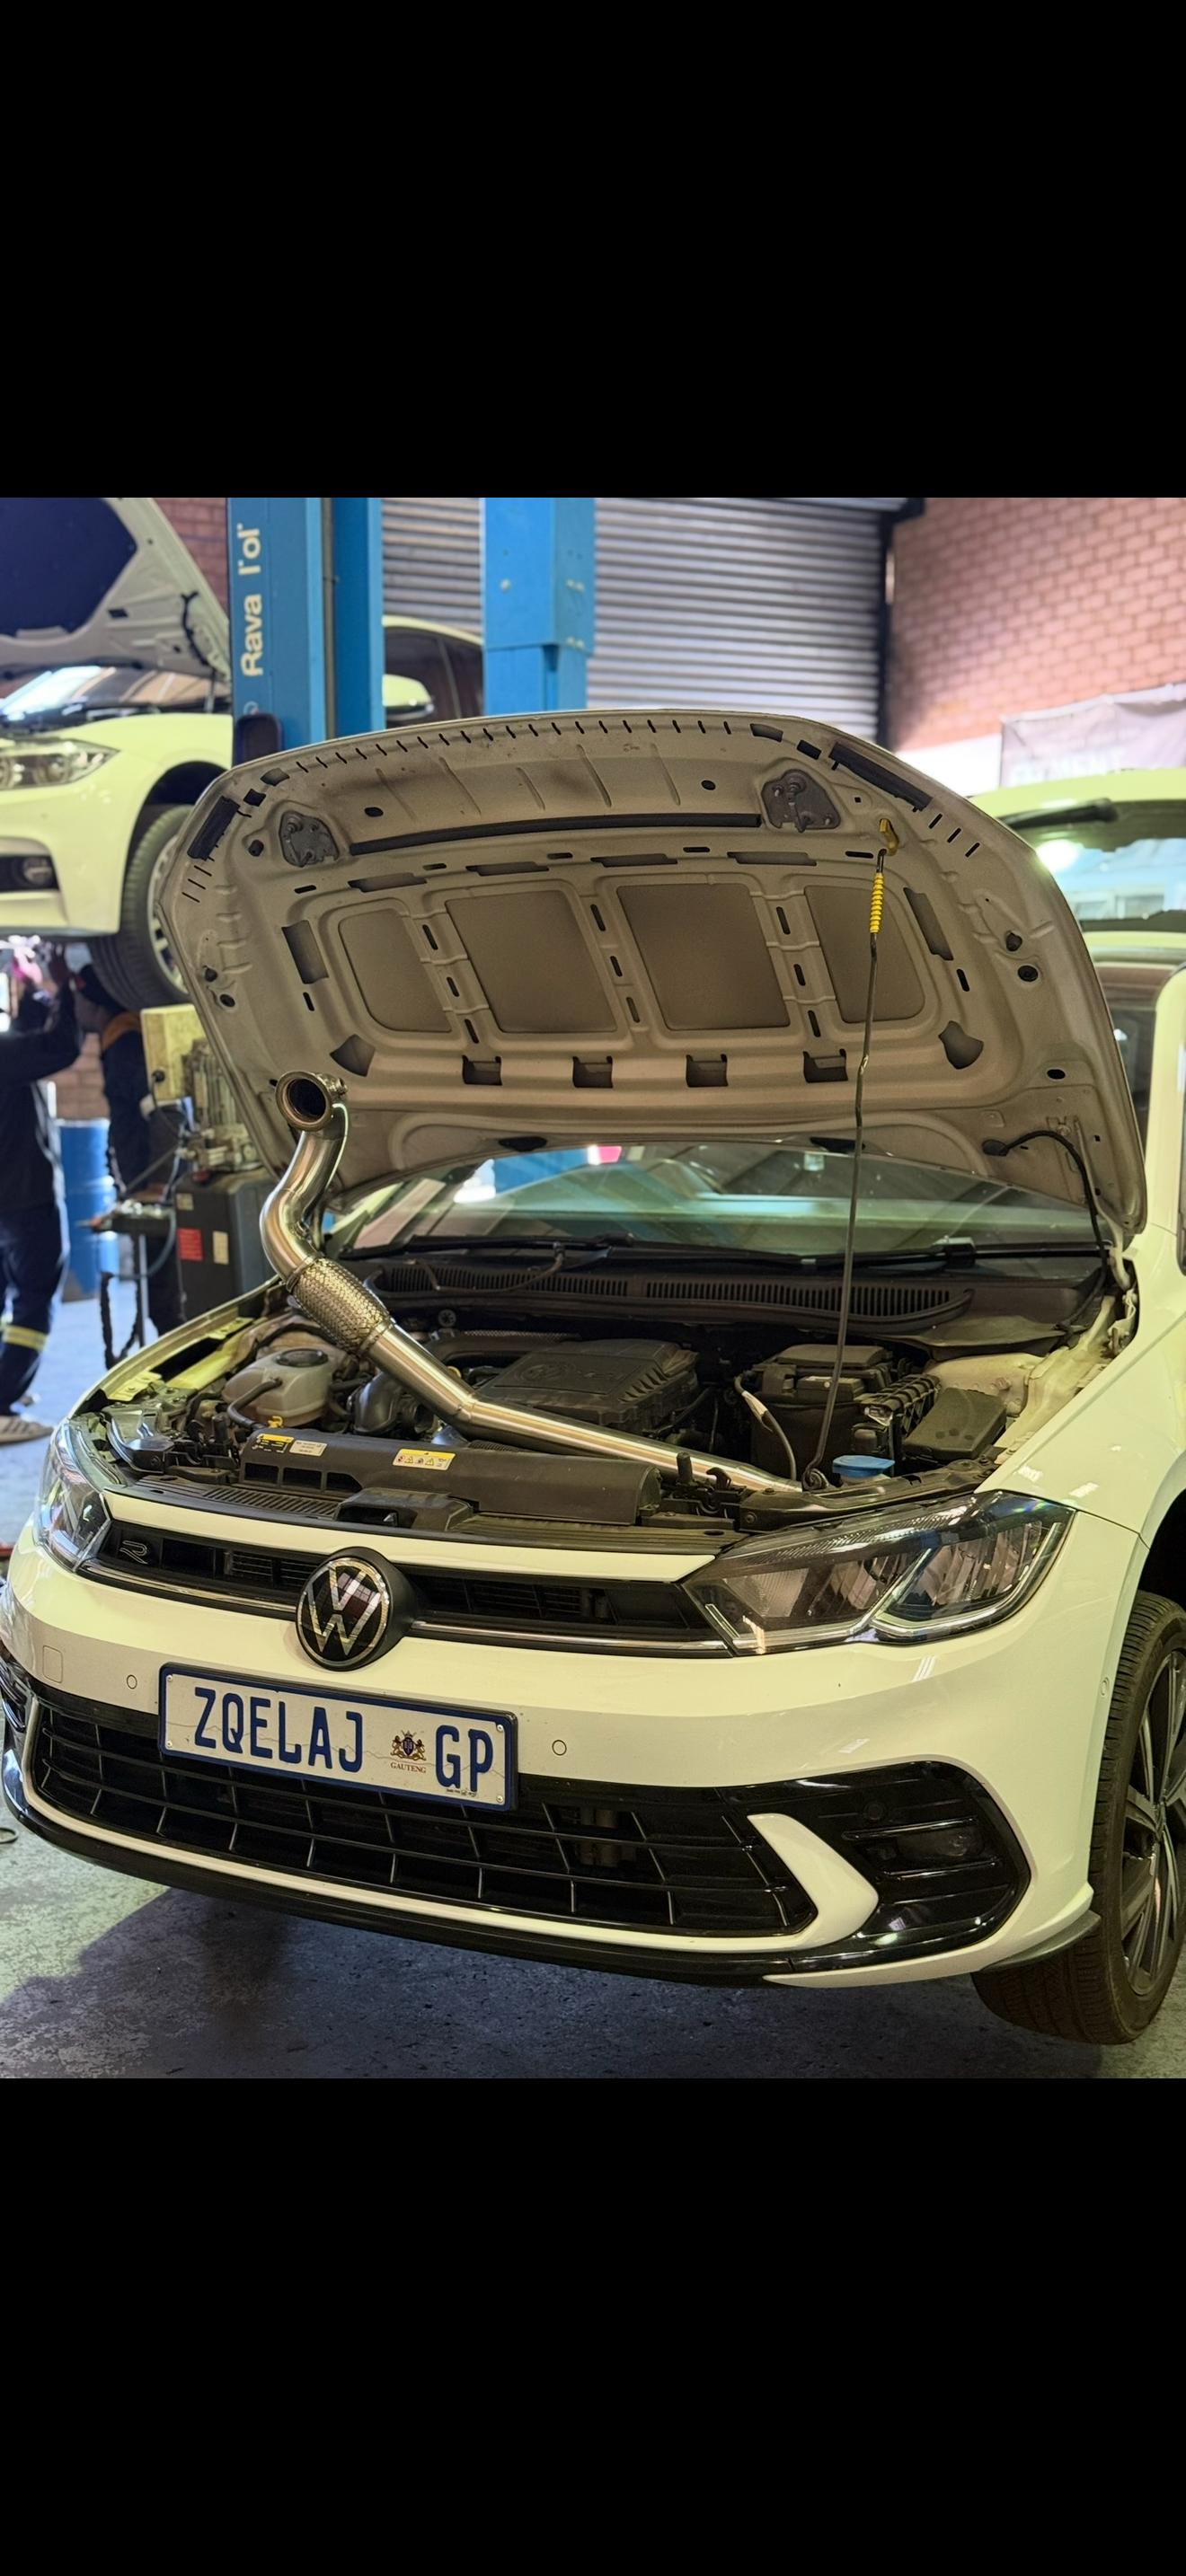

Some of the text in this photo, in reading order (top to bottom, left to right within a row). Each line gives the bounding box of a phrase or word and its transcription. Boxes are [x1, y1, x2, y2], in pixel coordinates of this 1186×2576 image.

[194, 1686, 493, 1792] ZQELAJ GP
[390, 1761, 427, 1774] GAUTENG
